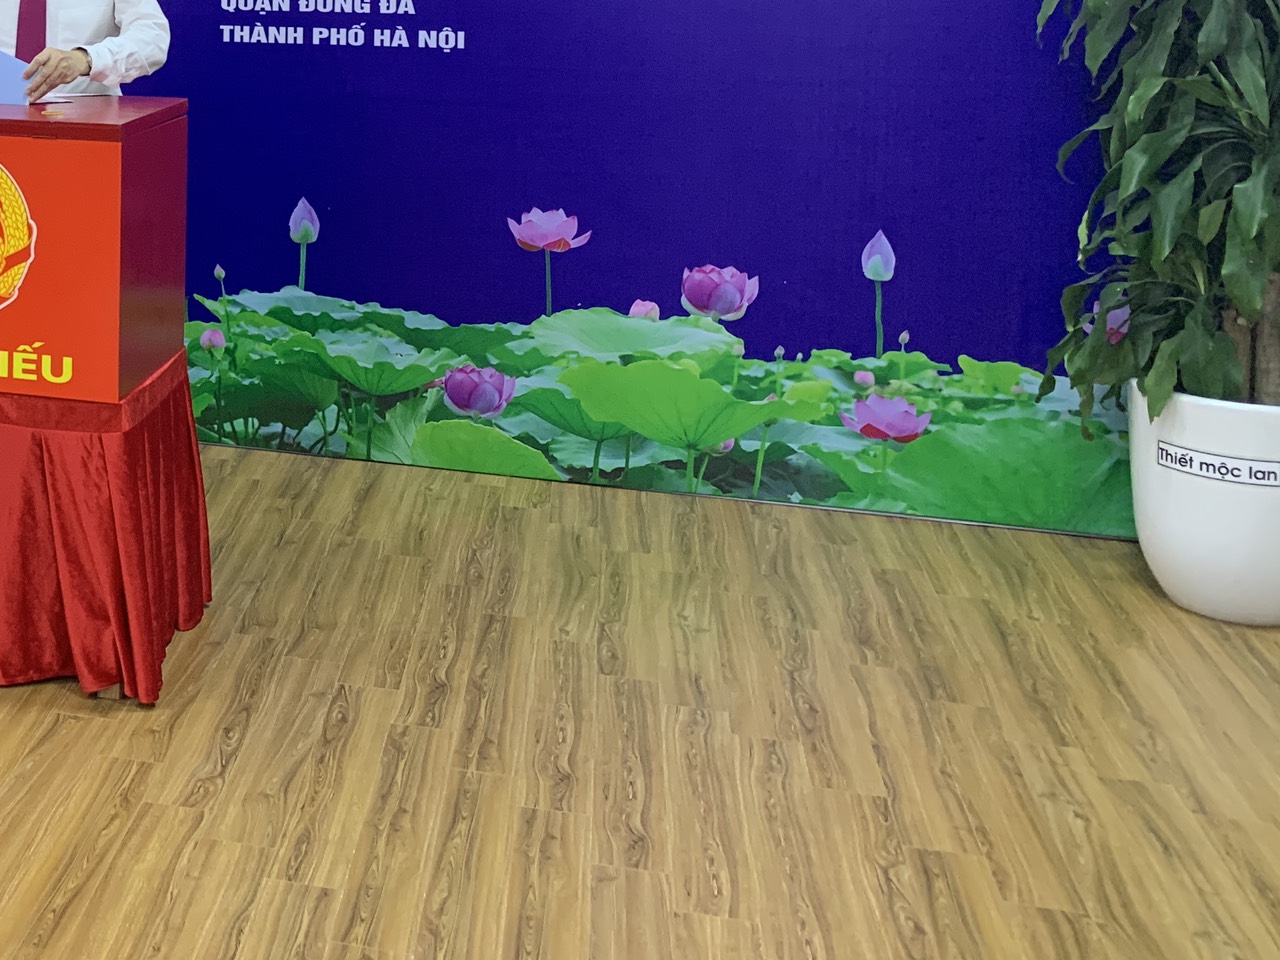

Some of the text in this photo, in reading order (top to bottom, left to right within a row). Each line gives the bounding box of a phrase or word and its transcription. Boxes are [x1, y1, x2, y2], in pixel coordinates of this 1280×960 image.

[219, 22, 466, 53] THÀNH PHỐ HÀ NỘI
[1159, 447, 1278, 482] Thiết mộc lan
